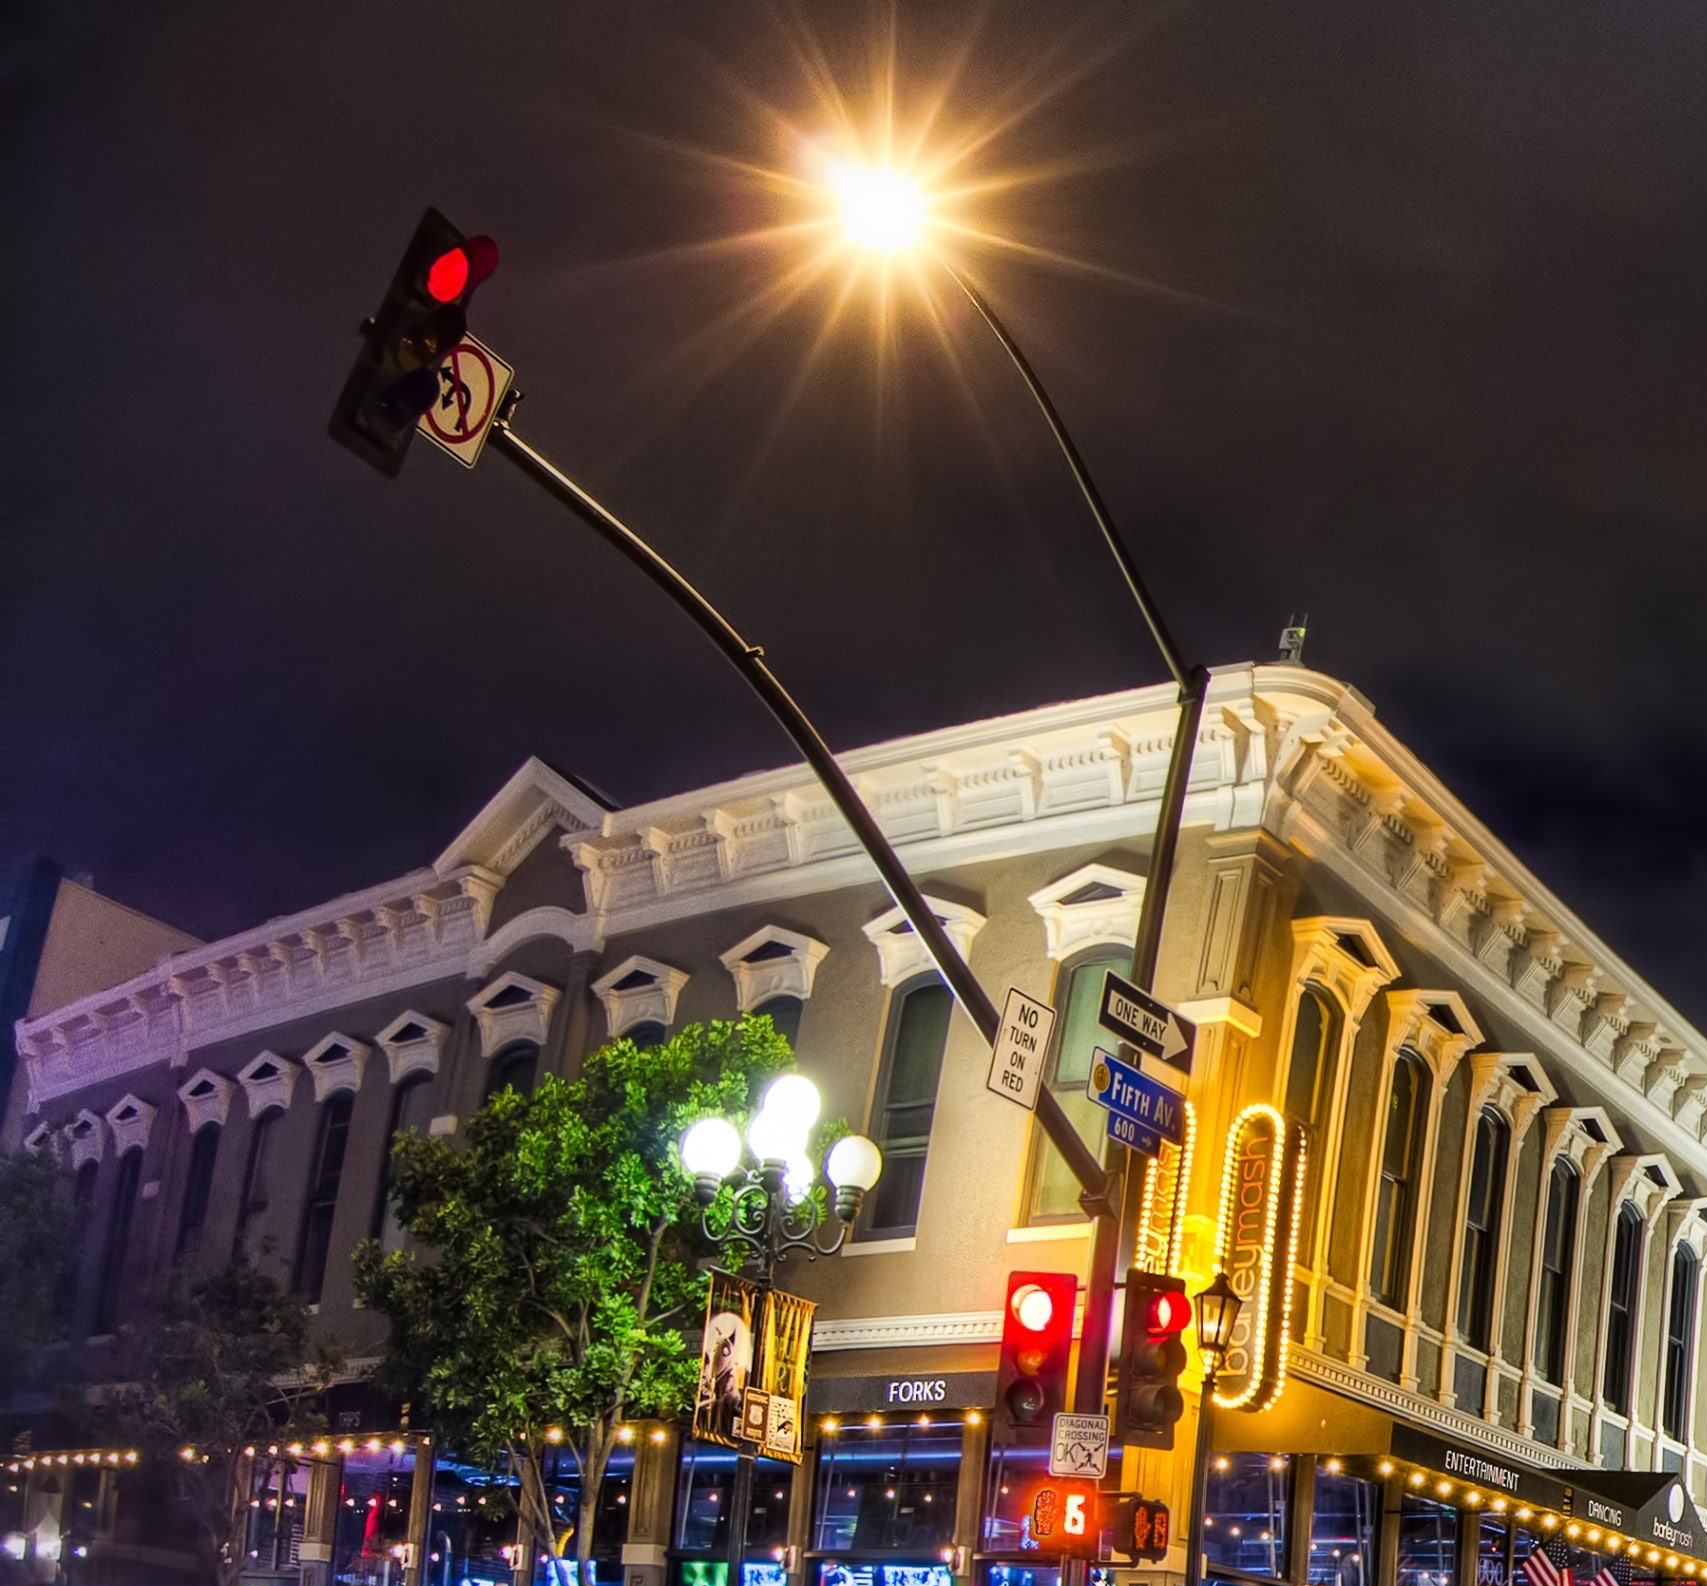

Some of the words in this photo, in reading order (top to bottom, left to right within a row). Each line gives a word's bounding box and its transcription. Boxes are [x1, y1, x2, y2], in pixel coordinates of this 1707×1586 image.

[1018, 1003, 1039, 1028] NO
[1115, 998, 1138, 1030] ONE
[1142, 1014, 1168, 1041] WAY
[1010, 1025, 1037, 1053] TURN
[1010, 1051, 1026, 1071] ON
[1001, 1069, 1024, 1093] RED
[1111, 1071, 1150, 1117] FIFTH
[1153, 1095, 1176, 1131] AV.
[1114, 1117, 1135, 1142] 600
[888, 1380, 946, 1402] FORKS
[1058, 1430, 1105, 1442] CROSSING
[1059, 1418, 1106, 1430] DIAGONAL
[1056, 1442, 1077, 1463] OK
[1445, 1450, 1520, 1492] ENTERTAINMENT
[1588, 1500, 1622, 1527] DANCING
